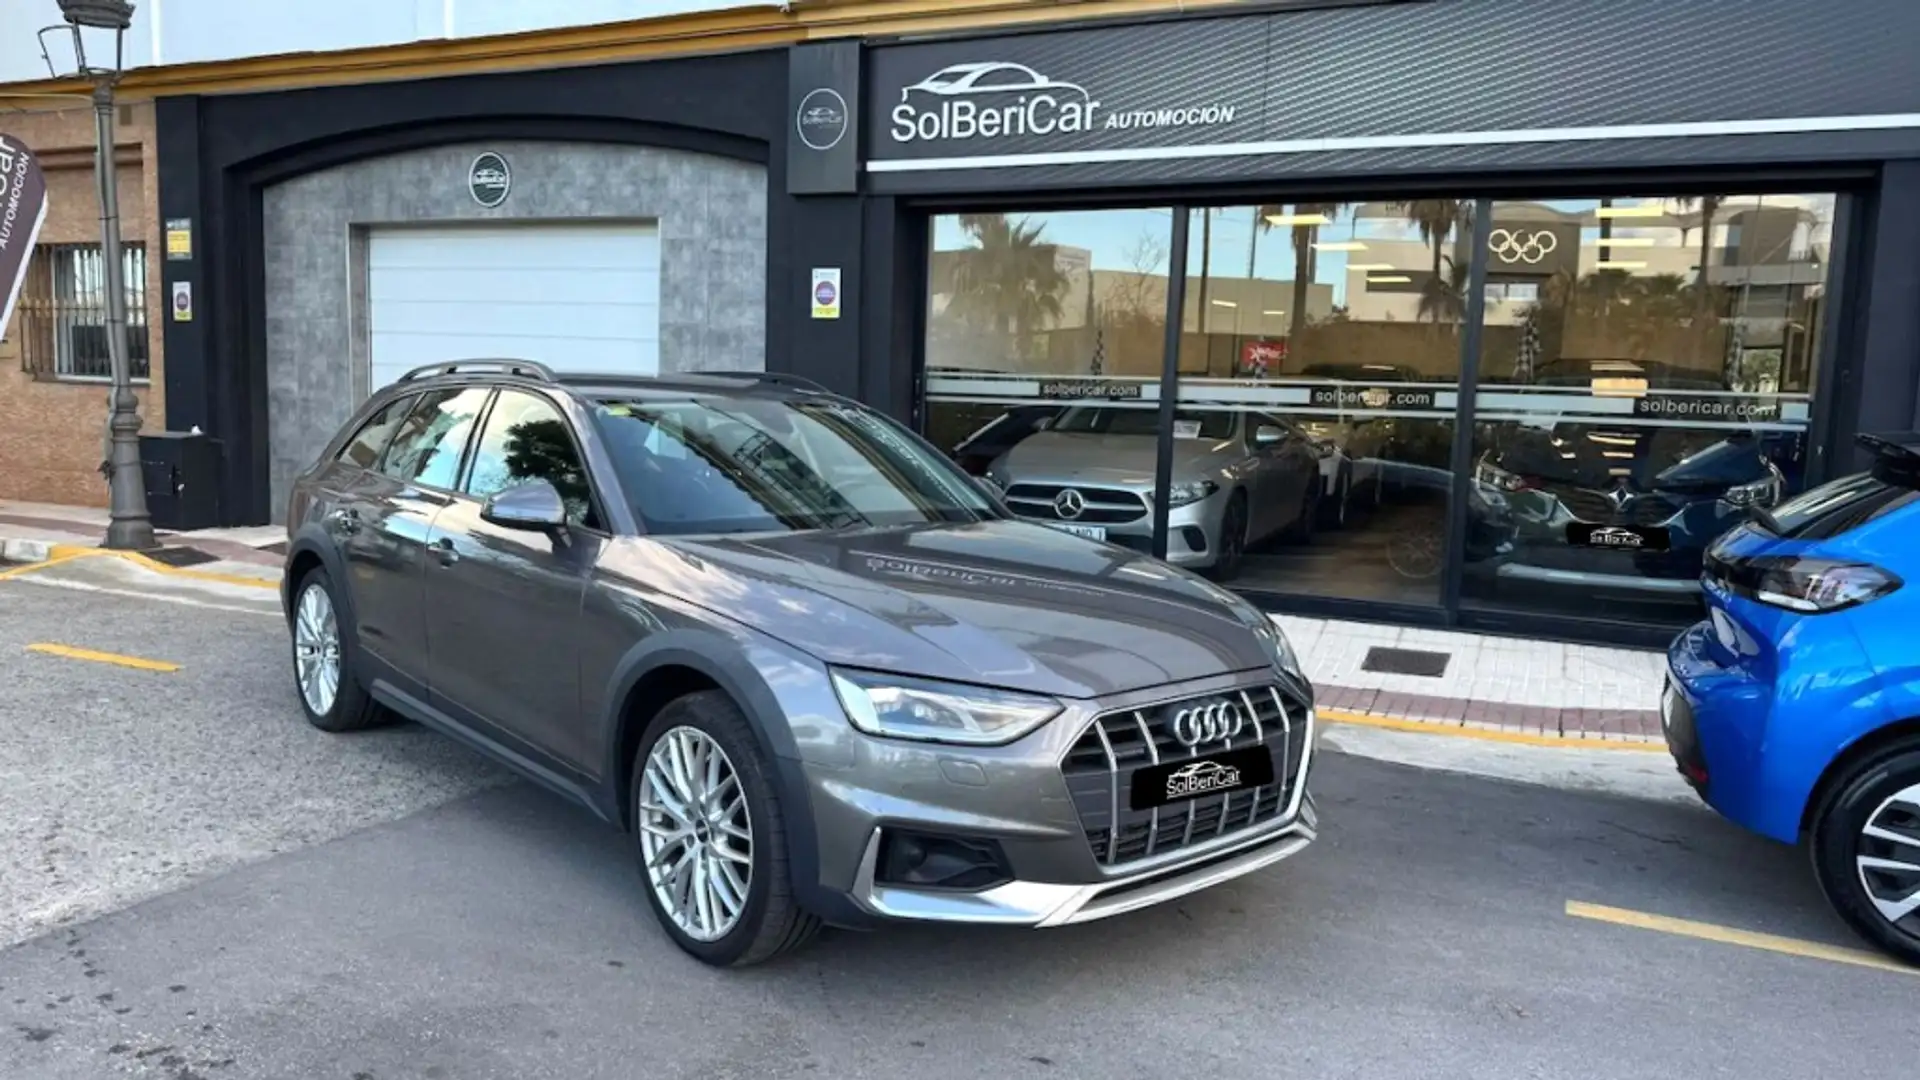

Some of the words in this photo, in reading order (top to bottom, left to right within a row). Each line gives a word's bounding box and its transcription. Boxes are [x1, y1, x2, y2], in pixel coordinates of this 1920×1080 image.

[891, 95, 1100, 142] SolBeriCar
[1105, 103, 1235, 129] AUTOMOCIÓN
[1640, 399, 1776, 416] solbericar.com
